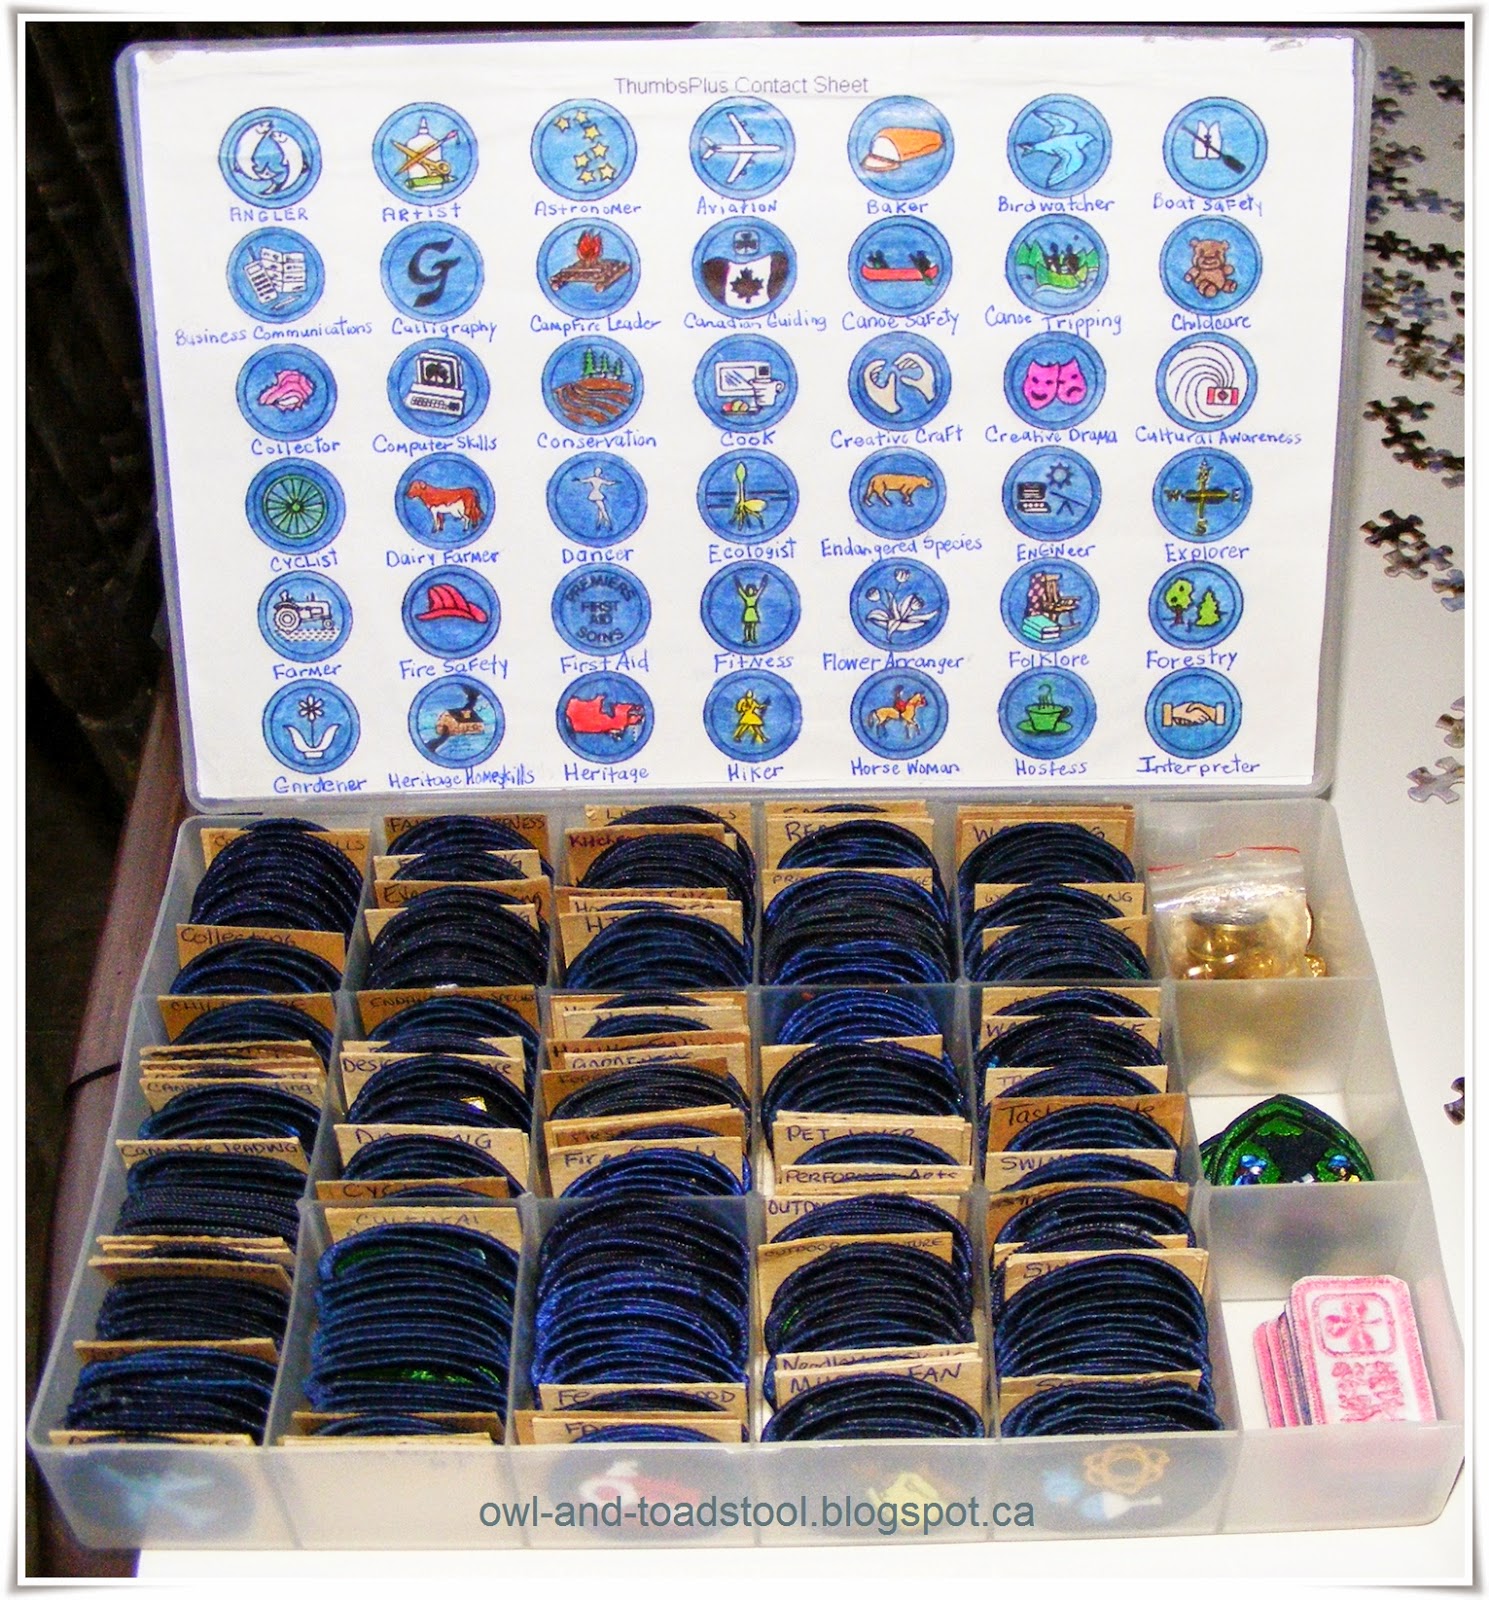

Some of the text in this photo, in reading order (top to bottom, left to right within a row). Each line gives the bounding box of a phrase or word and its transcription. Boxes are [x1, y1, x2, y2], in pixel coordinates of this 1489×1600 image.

[614, 76, 868, 94] ThumbsPlus Contact Sheet
[999, 196, 1115, 213] Birdwatcher
[1153, 193, 1194, 210] Boat
[229, 206, 309, 223] ANGLER
[608, 316, 662, 331] Leader
[684, 309, 828, 331] Canadian Guiding
[842, 312, 900, 330] Canoe
[985, 309, 1122, 336] Canoe Tripping
[175, 316, 373, 346] Business Communications
[392, 318, 498, 342] Calligraphy
[537, 430, 657, 449] Conservation
[830, 430, 909, 449] Creative
[984, 426, 1062, 443] Creative
[1135, 426, 1302, 445] Cultural Awareness
[251, 437, 341, 456] Collector
[372, 434, 497, 457] Computer Skills
[562, 548, 635, 564] Dancer
[708, 538, 797, 563] Ecologist
[820, 533, 983, 562] Endangered Species
[1165, 543, 1250, 562] Explorer
[386, 550, 436, 568] Dairy
[581, 600, 619, 613] FIRST
[589, 613, 613, 625] AID
[576, 626, 624, 643] SOINS
[399, 659, 440, 678] Fire
[560, 648, 649, 674] First Aid
[822, 652, 965, 675] Flower Arranger
[1146, 650, 1238, 671] Forestry
[563, 763, 650, 781] Heritage
[851, 759, 900, 776] Horse
[1014, 758, 1088, 777] Hostess
[1136, 756, 1261, 777] Interpreter
[388, 772, 463, 789] Heritage
